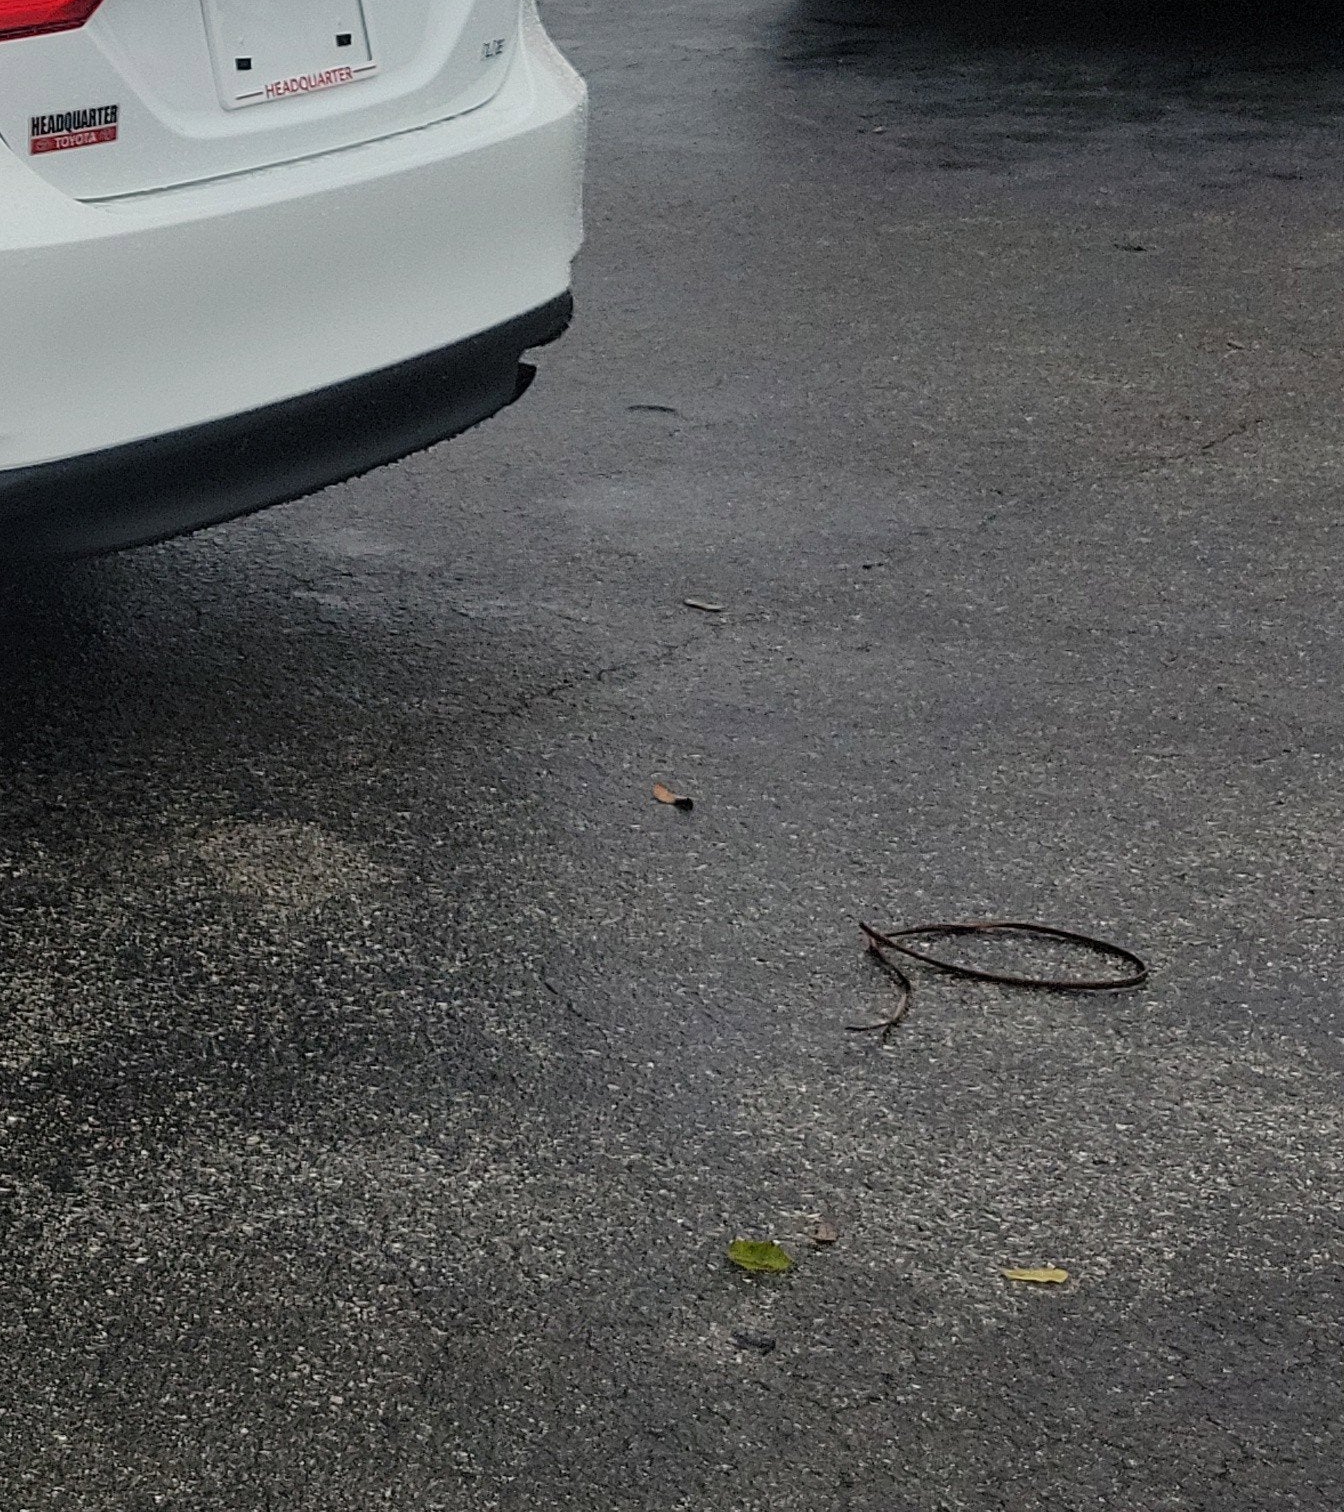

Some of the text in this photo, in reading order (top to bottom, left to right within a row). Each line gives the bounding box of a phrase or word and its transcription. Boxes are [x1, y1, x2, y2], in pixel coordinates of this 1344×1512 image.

[264, 66, 354, 99] HEADQUARTER
[31, 104, 119, 137] HEADQUARTER
[55, 131, 98, 149] TOYOTA
